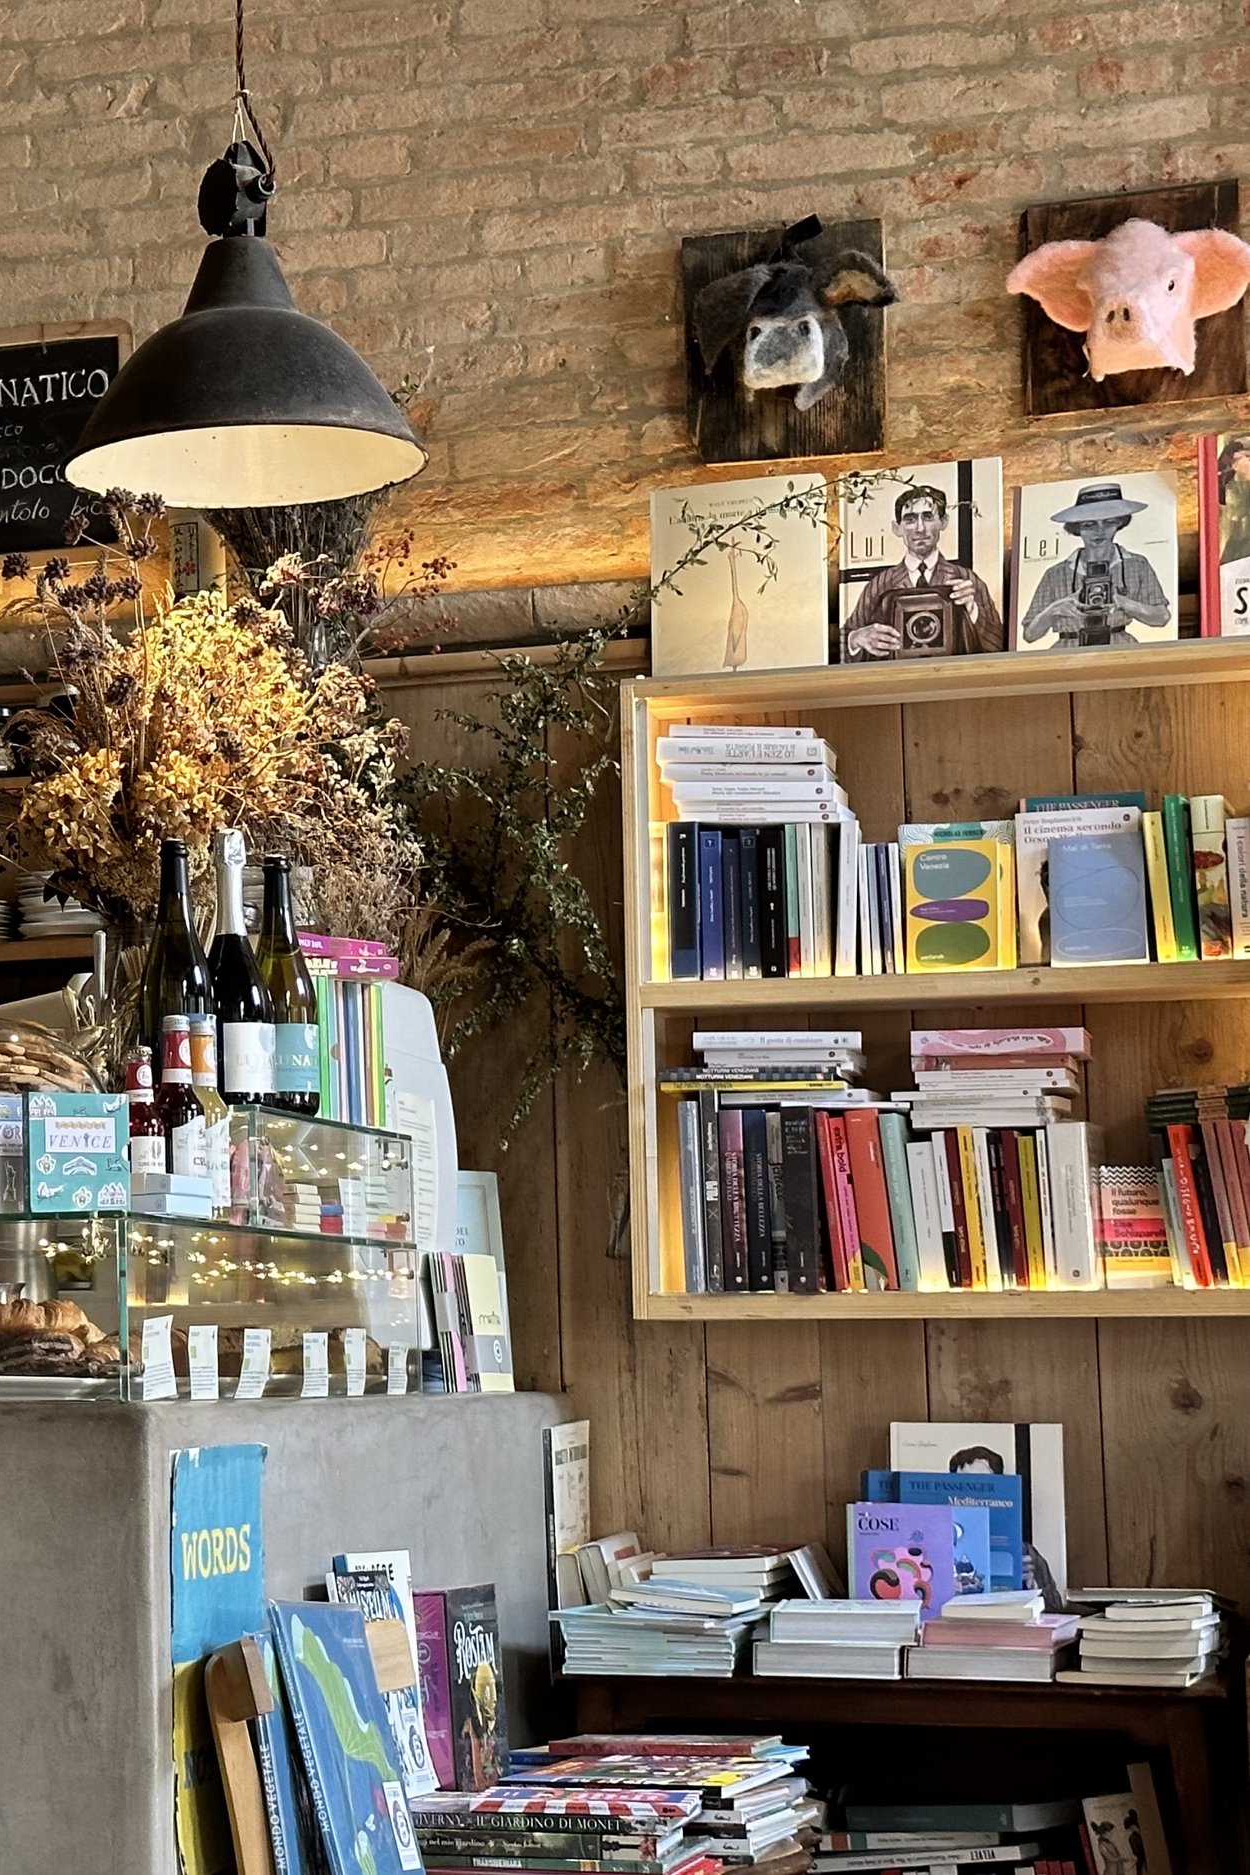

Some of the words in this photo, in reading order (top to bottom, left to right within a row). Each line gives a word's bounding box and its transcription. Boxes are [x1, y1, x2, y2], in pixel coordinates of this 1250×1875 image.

[1023, 532, 1060, 560] Lei
[1024, 826, 1032, 835] Il
[1034, 824, 1074, 834] cinema
[1076, 821, 1122, 832] secondo
[919, 853, 948, 862] Contro
[919, 862, 950, 871] Venezia
[46, 1133, 113, 1150] VENICE
[832, 1126, 845, 1152] extra
[835, 1151, 848, 1174] bold
[1111, 1198, 1160, 1207] qualunque
[909, 1481, 932, 1491] THE
[934, 1481, 996, 1493] PASSENGER
[947, 1495, 1014, 1508] Mediterraneo
[857, 1518, 899, 1532] COSE
[181, 1522, 251, 1581] WORDS
[294, 1710, 316, 1778] VEGETALE
[309, 1779, 331, 1833] MONDO
[476, 1815, 485, 1827] IL
[490, 1815, 554, 1830] GIARDINO
[558, 1817, 575, 1830] DI
[578, 1818, 622, 1832] MONET
